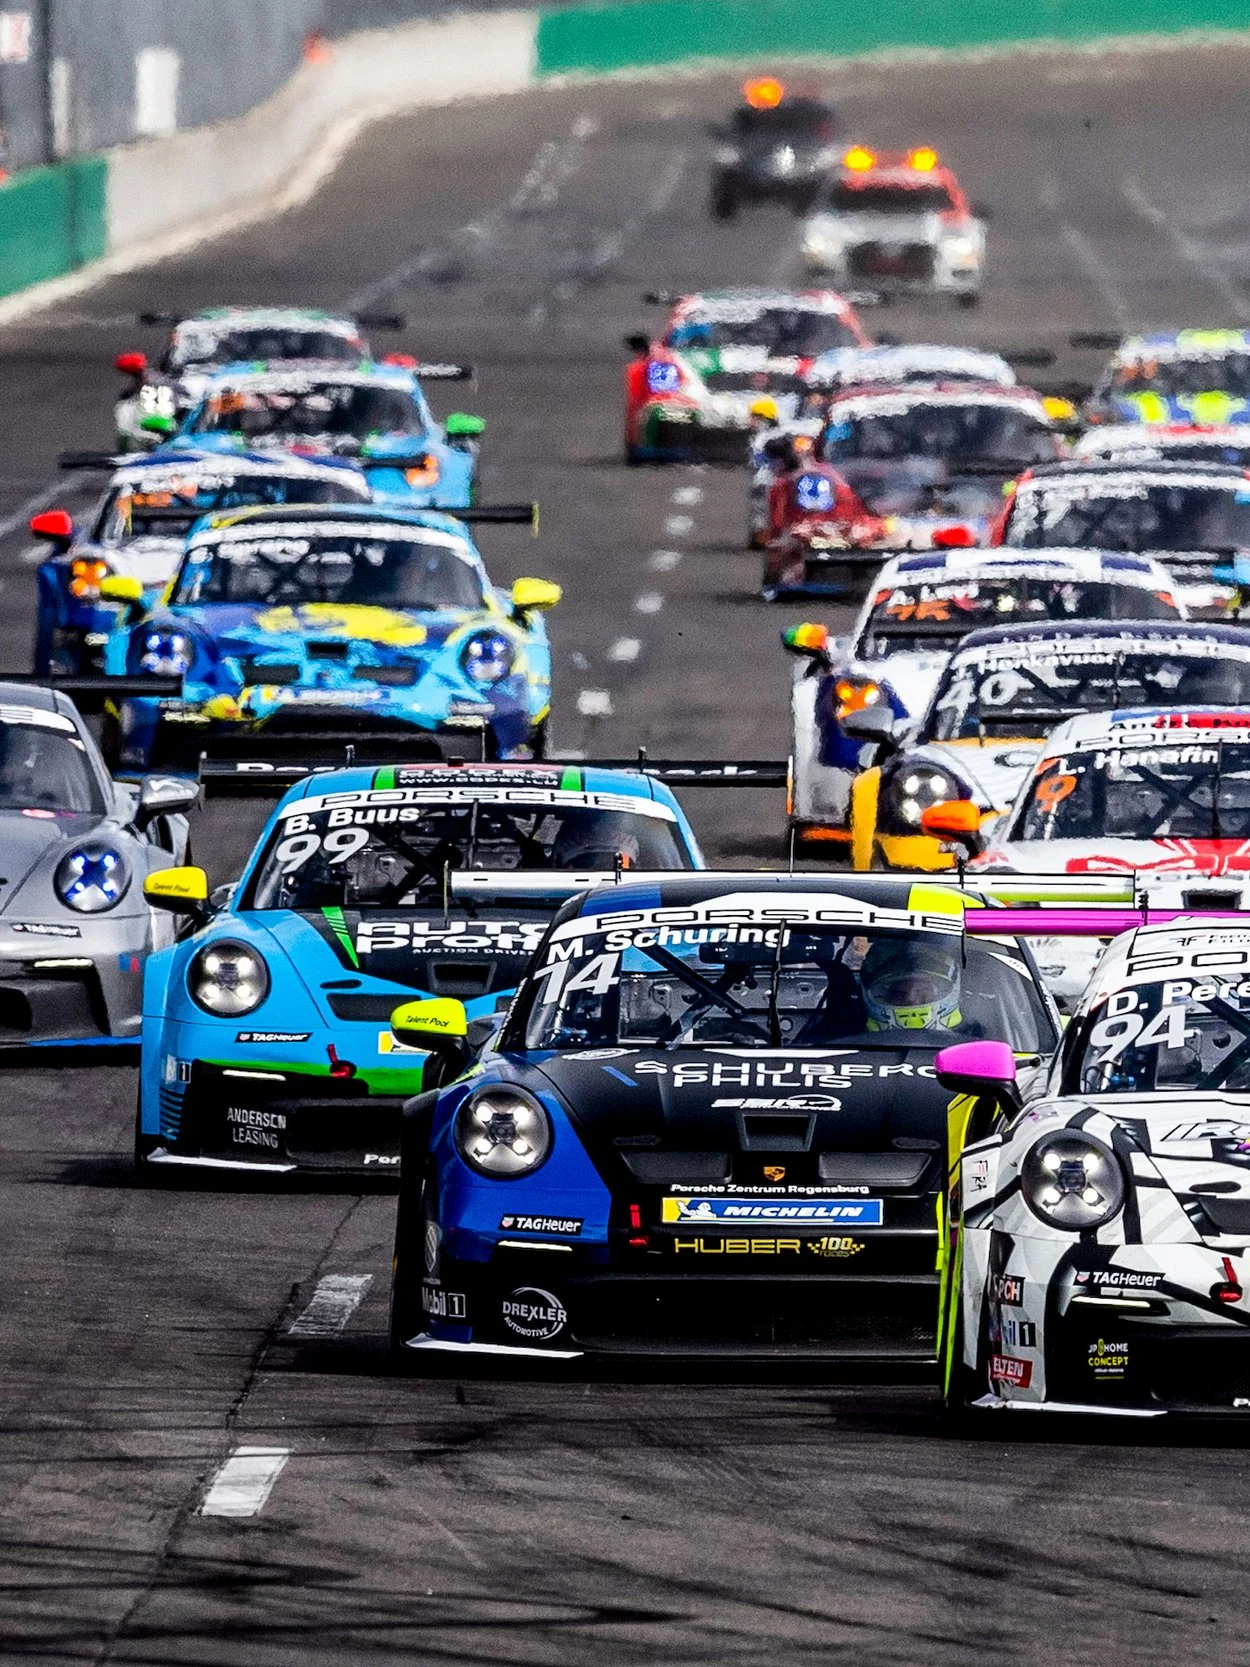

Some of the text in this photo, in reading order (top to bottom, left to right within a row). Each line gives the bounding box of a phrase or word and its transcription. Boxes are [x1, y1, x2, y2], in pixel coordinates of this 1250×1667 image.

[1096, 747, 1219, 769] Hanafin
[321, 789, 637, 810] PORSCHE
[284, 806, 420, 836] B. Buus
[274, 827, 370, 875] 99
[596, 907, 963, 932] PORSCHE
[547, 923, 791, 965] M. Schuring
[533, 952, 621, 1005] 14
[1106, 990, 1149, 1018] D.
[405, 1014, 449, 1028] Talent Pool
[1089, 1004, 1200, 1062] 94
[673, 1074, 853, 1089] PHILIS
[227, 1106, 286, 1129] ANDERSEN
[232, 1127, 278, 1149] LEASING
[670, 1183, 869, 1195] Porsche Zentrum Regensburg
[723, 1206, 865, 1218] MICHELIN
[516, 1217, 582, 1233] TAGHeuer
[674, 1237, 854, 1254] HUBER 100
[1093, 1271, 1161, 1287] TAGHeuer
[502, 1300, 568, 1323] DREXLER
[504, 1316, 549, 1337] AUTOMOTIVE
[993, 1357, 1024, 1378] ELTEN
[1088, 1356, 1129, 1367] CONCEPT
